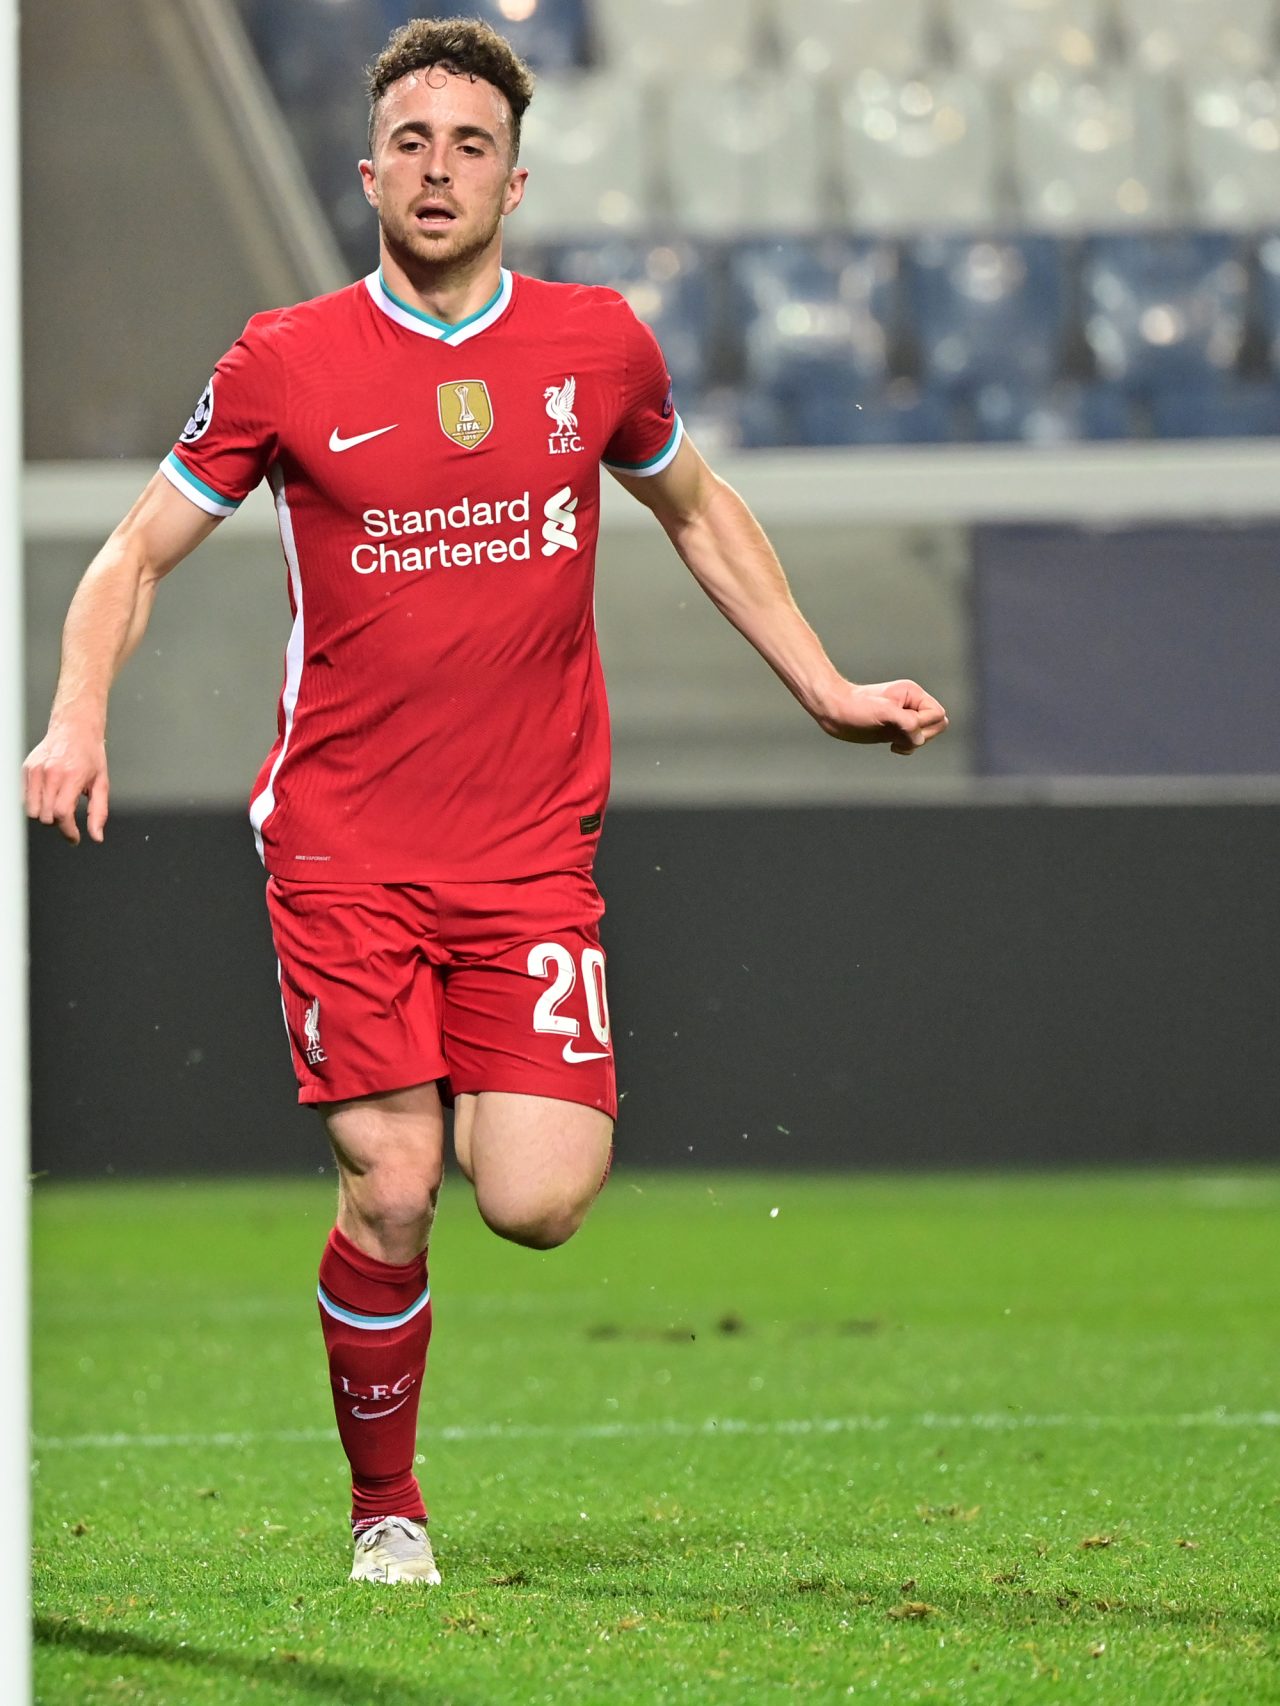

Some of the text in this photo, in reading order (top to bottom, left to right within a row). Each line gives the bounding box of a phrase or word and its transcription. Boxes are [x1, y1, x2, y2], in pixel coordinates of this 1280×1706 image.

[456, 421, 480, 432] FIFA
[548, 436, 585, 454] L.F.C.
[362, 491, 530, 537] Standard
[351, 529, 531, 574] Chartered
[527, 942, 609, 1047] 20
[341, 1373, 416, 1401] L.F.C.
